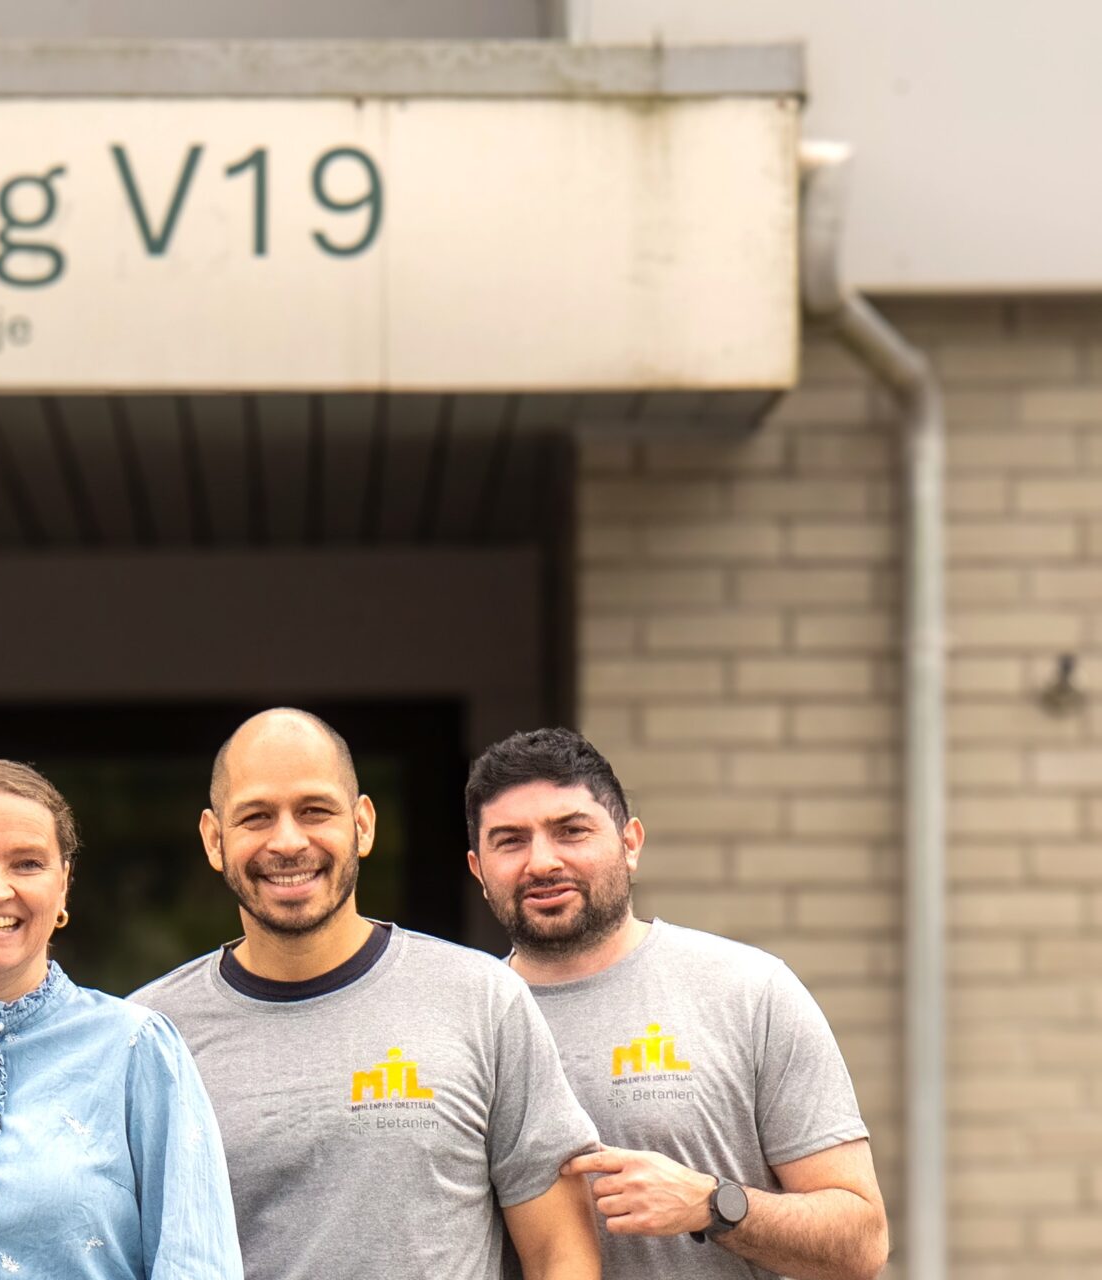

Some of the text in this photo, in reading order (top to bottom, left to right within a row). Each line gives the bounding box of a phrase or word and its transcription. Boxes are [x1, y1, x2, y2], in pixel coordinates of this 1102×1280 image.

[109, 143, 388, 260] V19
[632, 1088, 695, 1102] Betanien
[376, 1115, 439, 1130] Betanien
